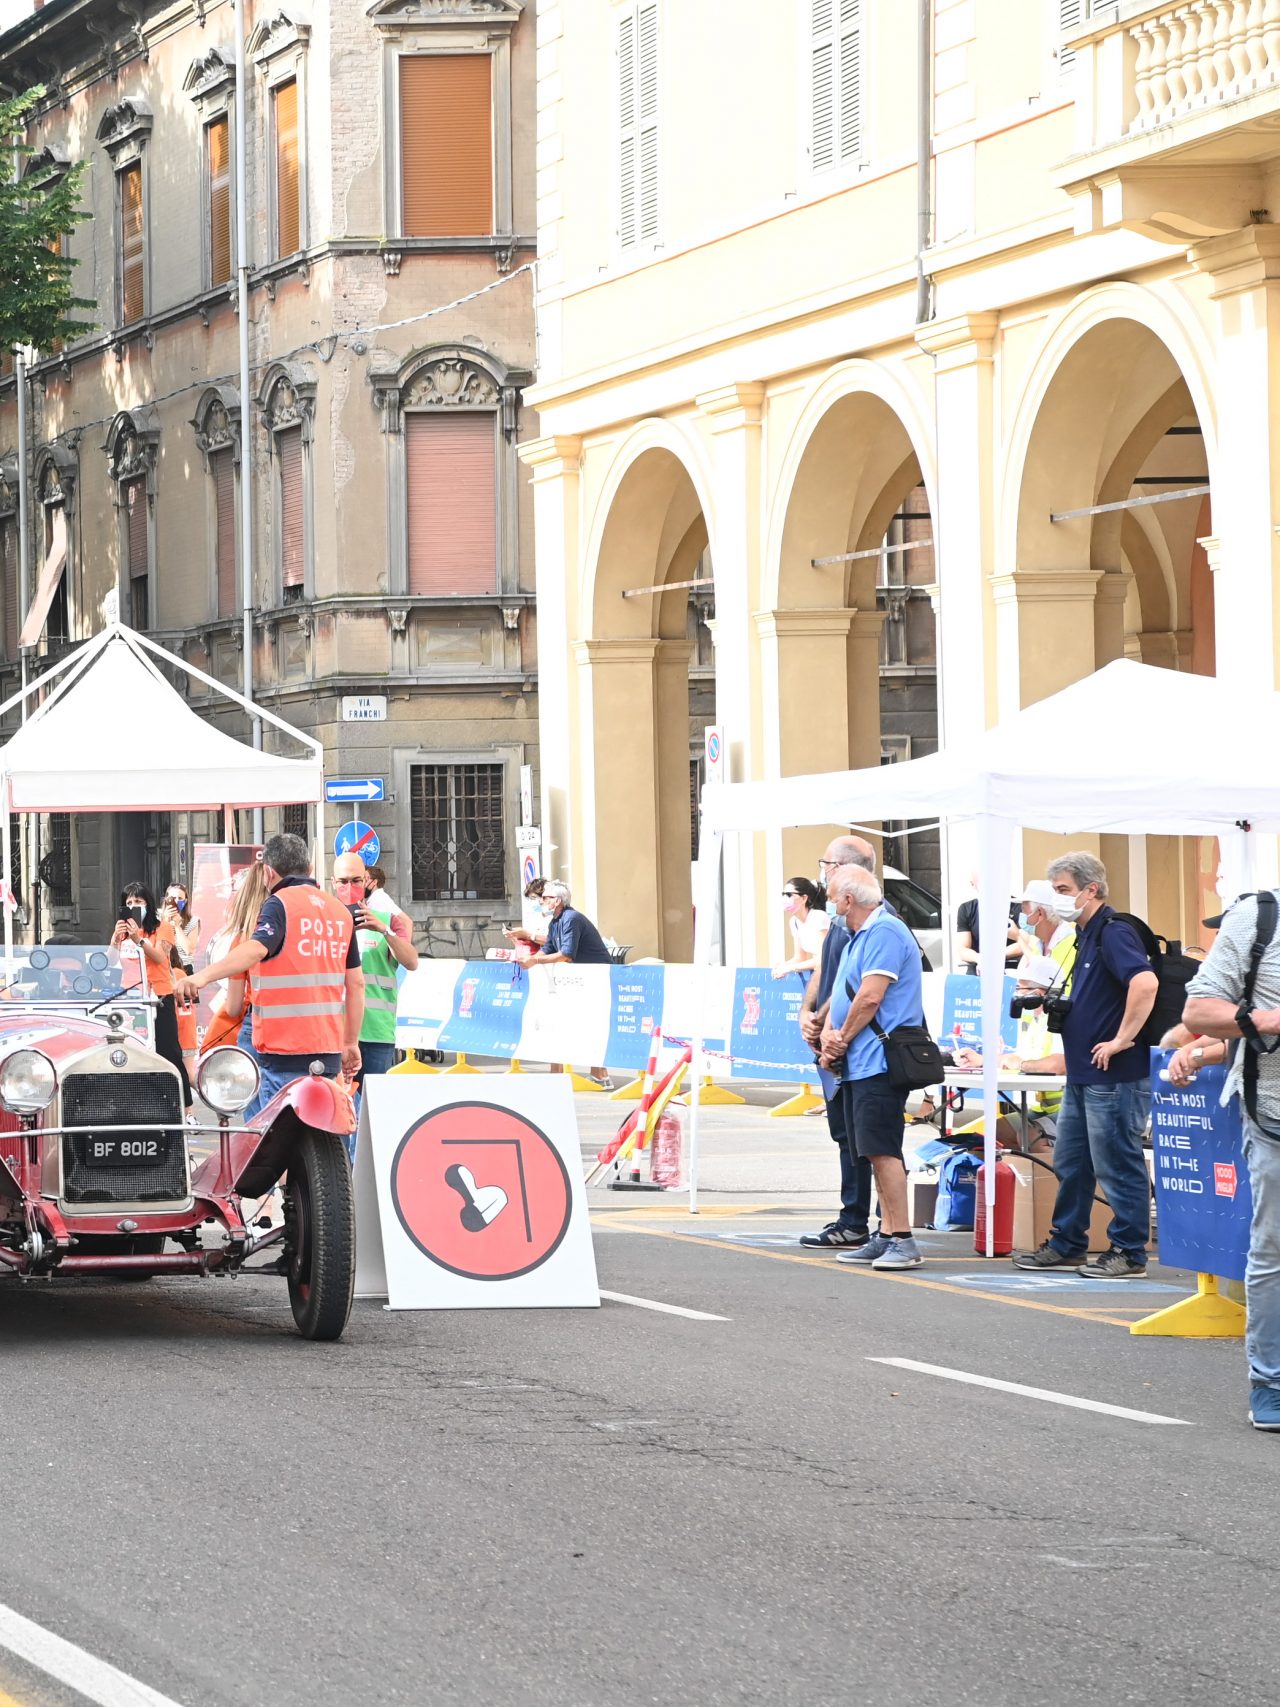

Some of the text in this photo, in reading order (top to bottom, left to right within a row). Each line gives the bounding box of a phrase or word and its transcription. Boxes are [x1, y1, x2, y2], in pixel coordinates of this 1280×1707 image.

[358, 698, 371, 707] VIA
[348, 709, 381, 719] FRANCHI
[300, 918, 346, 938] POST
[297, 938, 348, 960] CHIEF
[618, 985, 630, 993] THE
[954, 998, 972, 1007] THE
[954, 1010, 983, 1019] BEAUTIF
[1153, 1091, 1207, 1109] THE MOST
[1156, 1112, 1214, 1131] BEAUTIFUL
[93, 1141, 158, 1157] BF 8012
[1158, 1133, 1192, 1150] RACE
[1160, 1154, 1200, 1172] IN THE
[1161, 1176, 1204, 1194] WORLD
